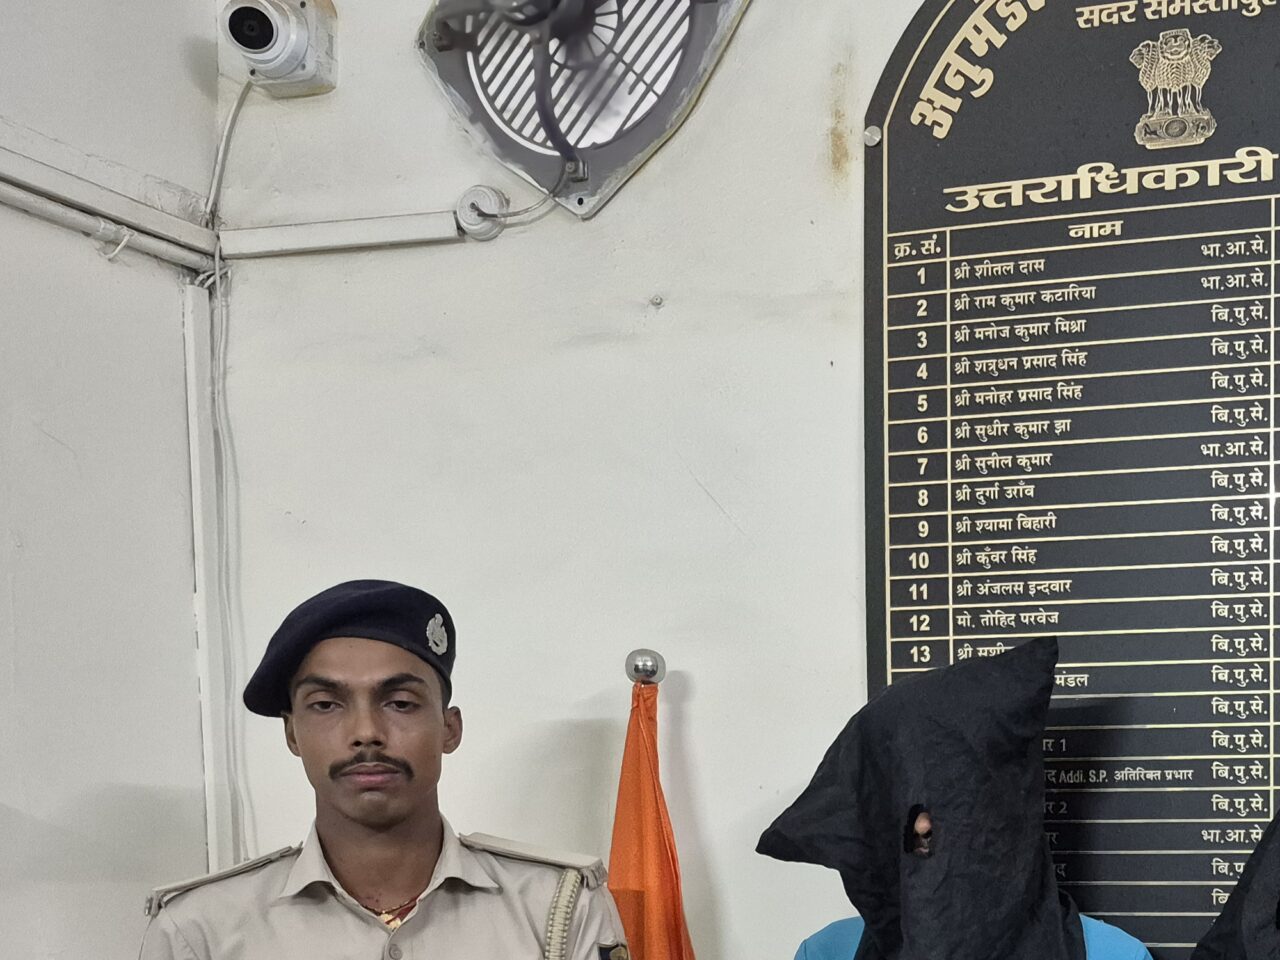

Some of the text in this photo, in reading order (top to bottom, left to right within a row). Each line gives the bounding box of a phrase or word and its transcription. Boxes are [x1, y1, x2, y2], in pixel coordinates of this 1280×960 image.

[1075, 0, 1138, 28] सदर
[943, 146, 1279, 212] उत्तराधिकारी
[1068, 221, 1123, 238] नाम
[954, 259, 1045, 279] श्री शीतल दास
[955, 284, 1096, 311] श्री राम कुमार कटारिया
[954, 317, 1087, 342] श्री मनोज कुमार मिश्रा
[917, 331, 927, 348] 3
[955, 357, 970, 374] श्री
[1022, 354, 1057, 369] प्रसाद
[1061, 349, 1088, 366] सिंह
[918, 395, 927, 411] 5
[955, 382, 1083, 406] श्री मनोहर प्रसाद सिंह
[955, 419, 1071, 442] श्री सुधीर कुमार झा
[918, 458, 928, 475] 7
[955, 452, 1053, 474] श्री सुनील कुमार
[956, 484, 971, 501] श्री
[974, 482, 1000, 505] दुर्गा
[918, 521, 928, 537] 9
[956, 512, 1057, 533] श्री श्यामा बिहारी
[956, 548, 972, 565] श्री
[1011, 546, 1037, 564] सिंह
[957, 580, 972, 596] श्री
[910, 615, 930, 631] 12
[1019, 608, 1059, 624] परवेज
[910, 646, 930, 662] 13
[957, 643, 973, 660] श्री
